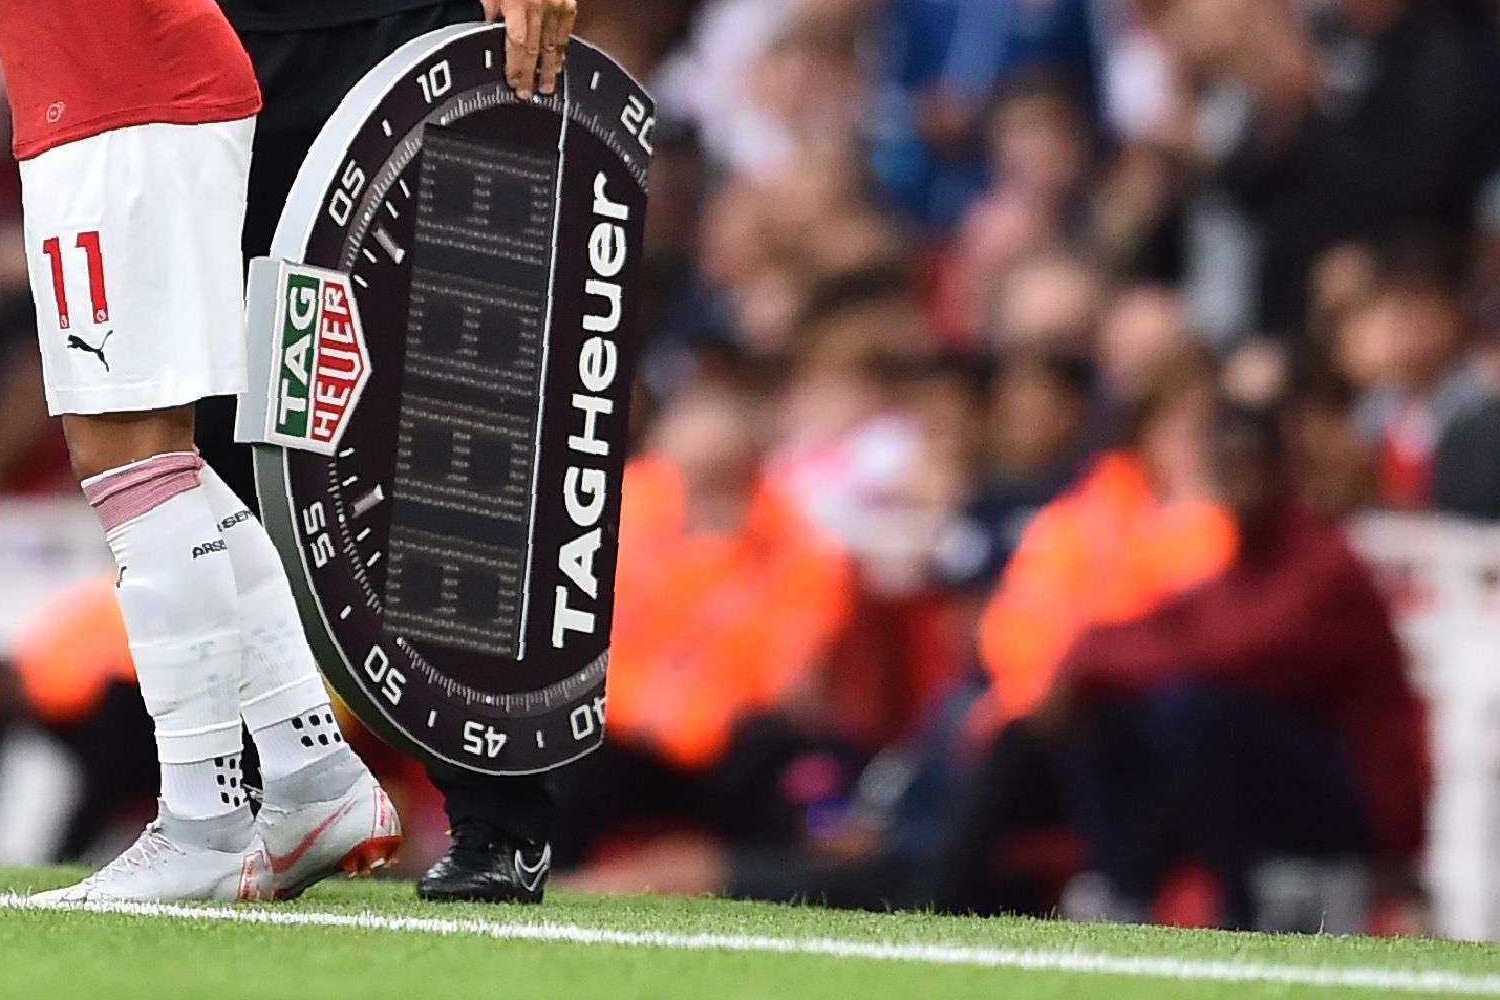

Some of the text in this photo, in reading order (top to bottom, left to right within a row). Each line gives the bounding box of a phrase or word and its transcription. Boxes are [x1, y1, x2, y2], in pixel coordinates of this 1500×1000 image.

[416, 60, 452, 103] 10
[328, 159, 366, 228] 05
[42, 230, 109, 330] 11
[279, 286, 317, 425] TAG
[314, 286, 361, 438] HEUER
[303, 500, 336, 569] 55
[364, 644, 407, 706] 50
[462, 720, 507, 759] 45
